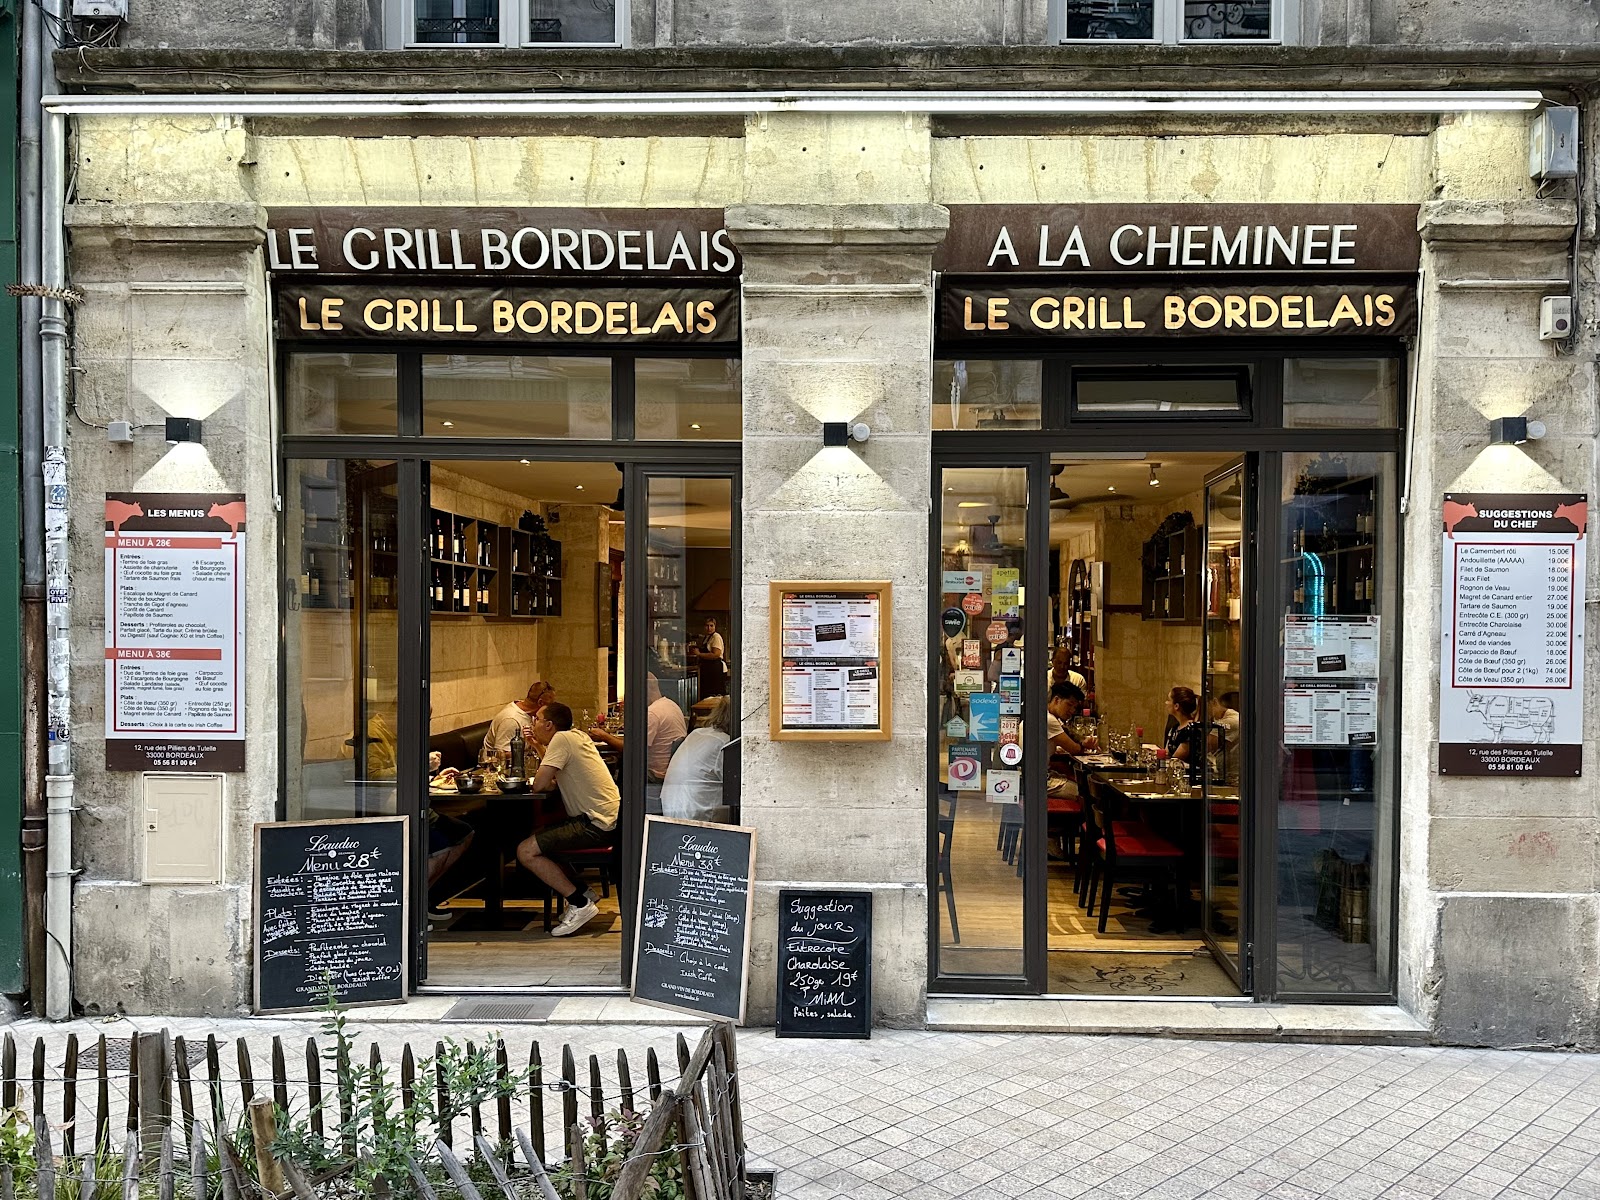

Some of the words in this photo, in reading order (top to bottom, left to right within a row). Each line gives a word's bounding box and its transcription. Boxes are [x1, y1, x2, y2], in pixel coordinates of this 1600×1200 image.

[266, 227, 319, 272] LE
[342, 227, 476, 272] GRILL
[481, 227, 736, 273] BORDELAIS
[987, 224, 1019, 267] A
[1038, 224, 1091, 267] LA
[1110, 224, 1357, 267] CHEMINEE
[299, 297, 343, 332] LE
[363, 298, 478, 333] GRILL
[492, 300, 717, 335] BORDELAIS
[964, 296, 1009, 331] LE
[1029, 296, 1146, 331] GRILL
[1164, 294, 1396, 330] BORDELAIS
[1479, 510, 1552, 518] SUGGESTIONS
[1494, 520, 1509, 528] DU
[1511, 520, 1538, 528] CHEF
[147, 538, 153, 546] À
[147, 649, 153, 658] À
[298, 857, 341, 873] Menu
[342, 847, 382, 868] 28€
[790, 898, 854, 920] Suggestion
[790, 921, 804, 932] du
